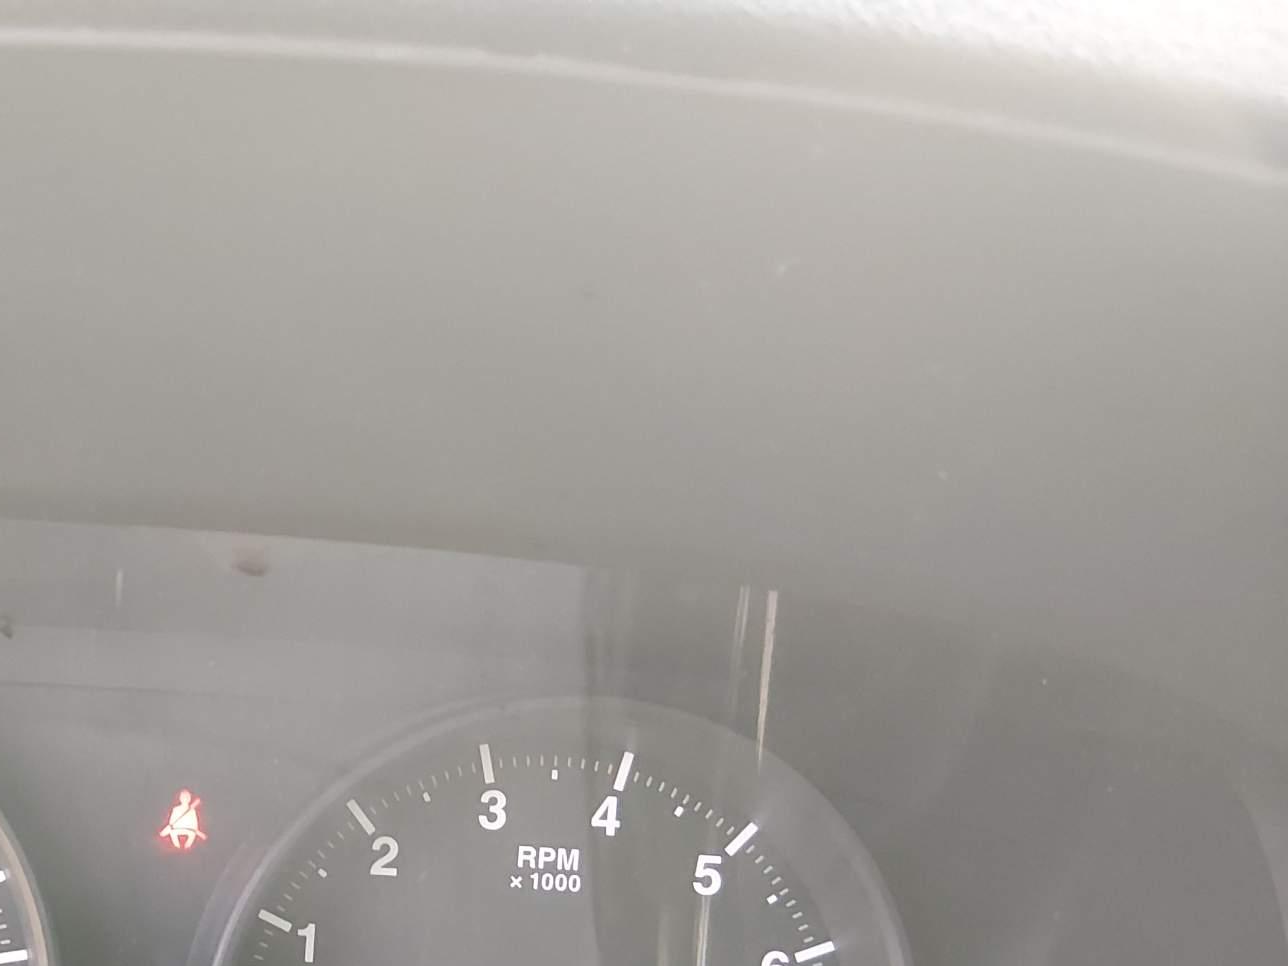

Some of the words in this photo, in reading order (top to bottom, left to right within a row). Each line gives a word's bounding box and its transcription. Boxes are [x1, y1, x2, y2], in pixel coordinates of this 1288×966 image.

[478, 791, 507, 831] 3
[591, 796, 621, 836] 4
[370, 838, 399, 876] 2
[516, 846, 580, 871] RPM
[693, 855, 722, 895] 5
[529, 872, 581, 893] 1000
[296, 923, 316, 962] 1
